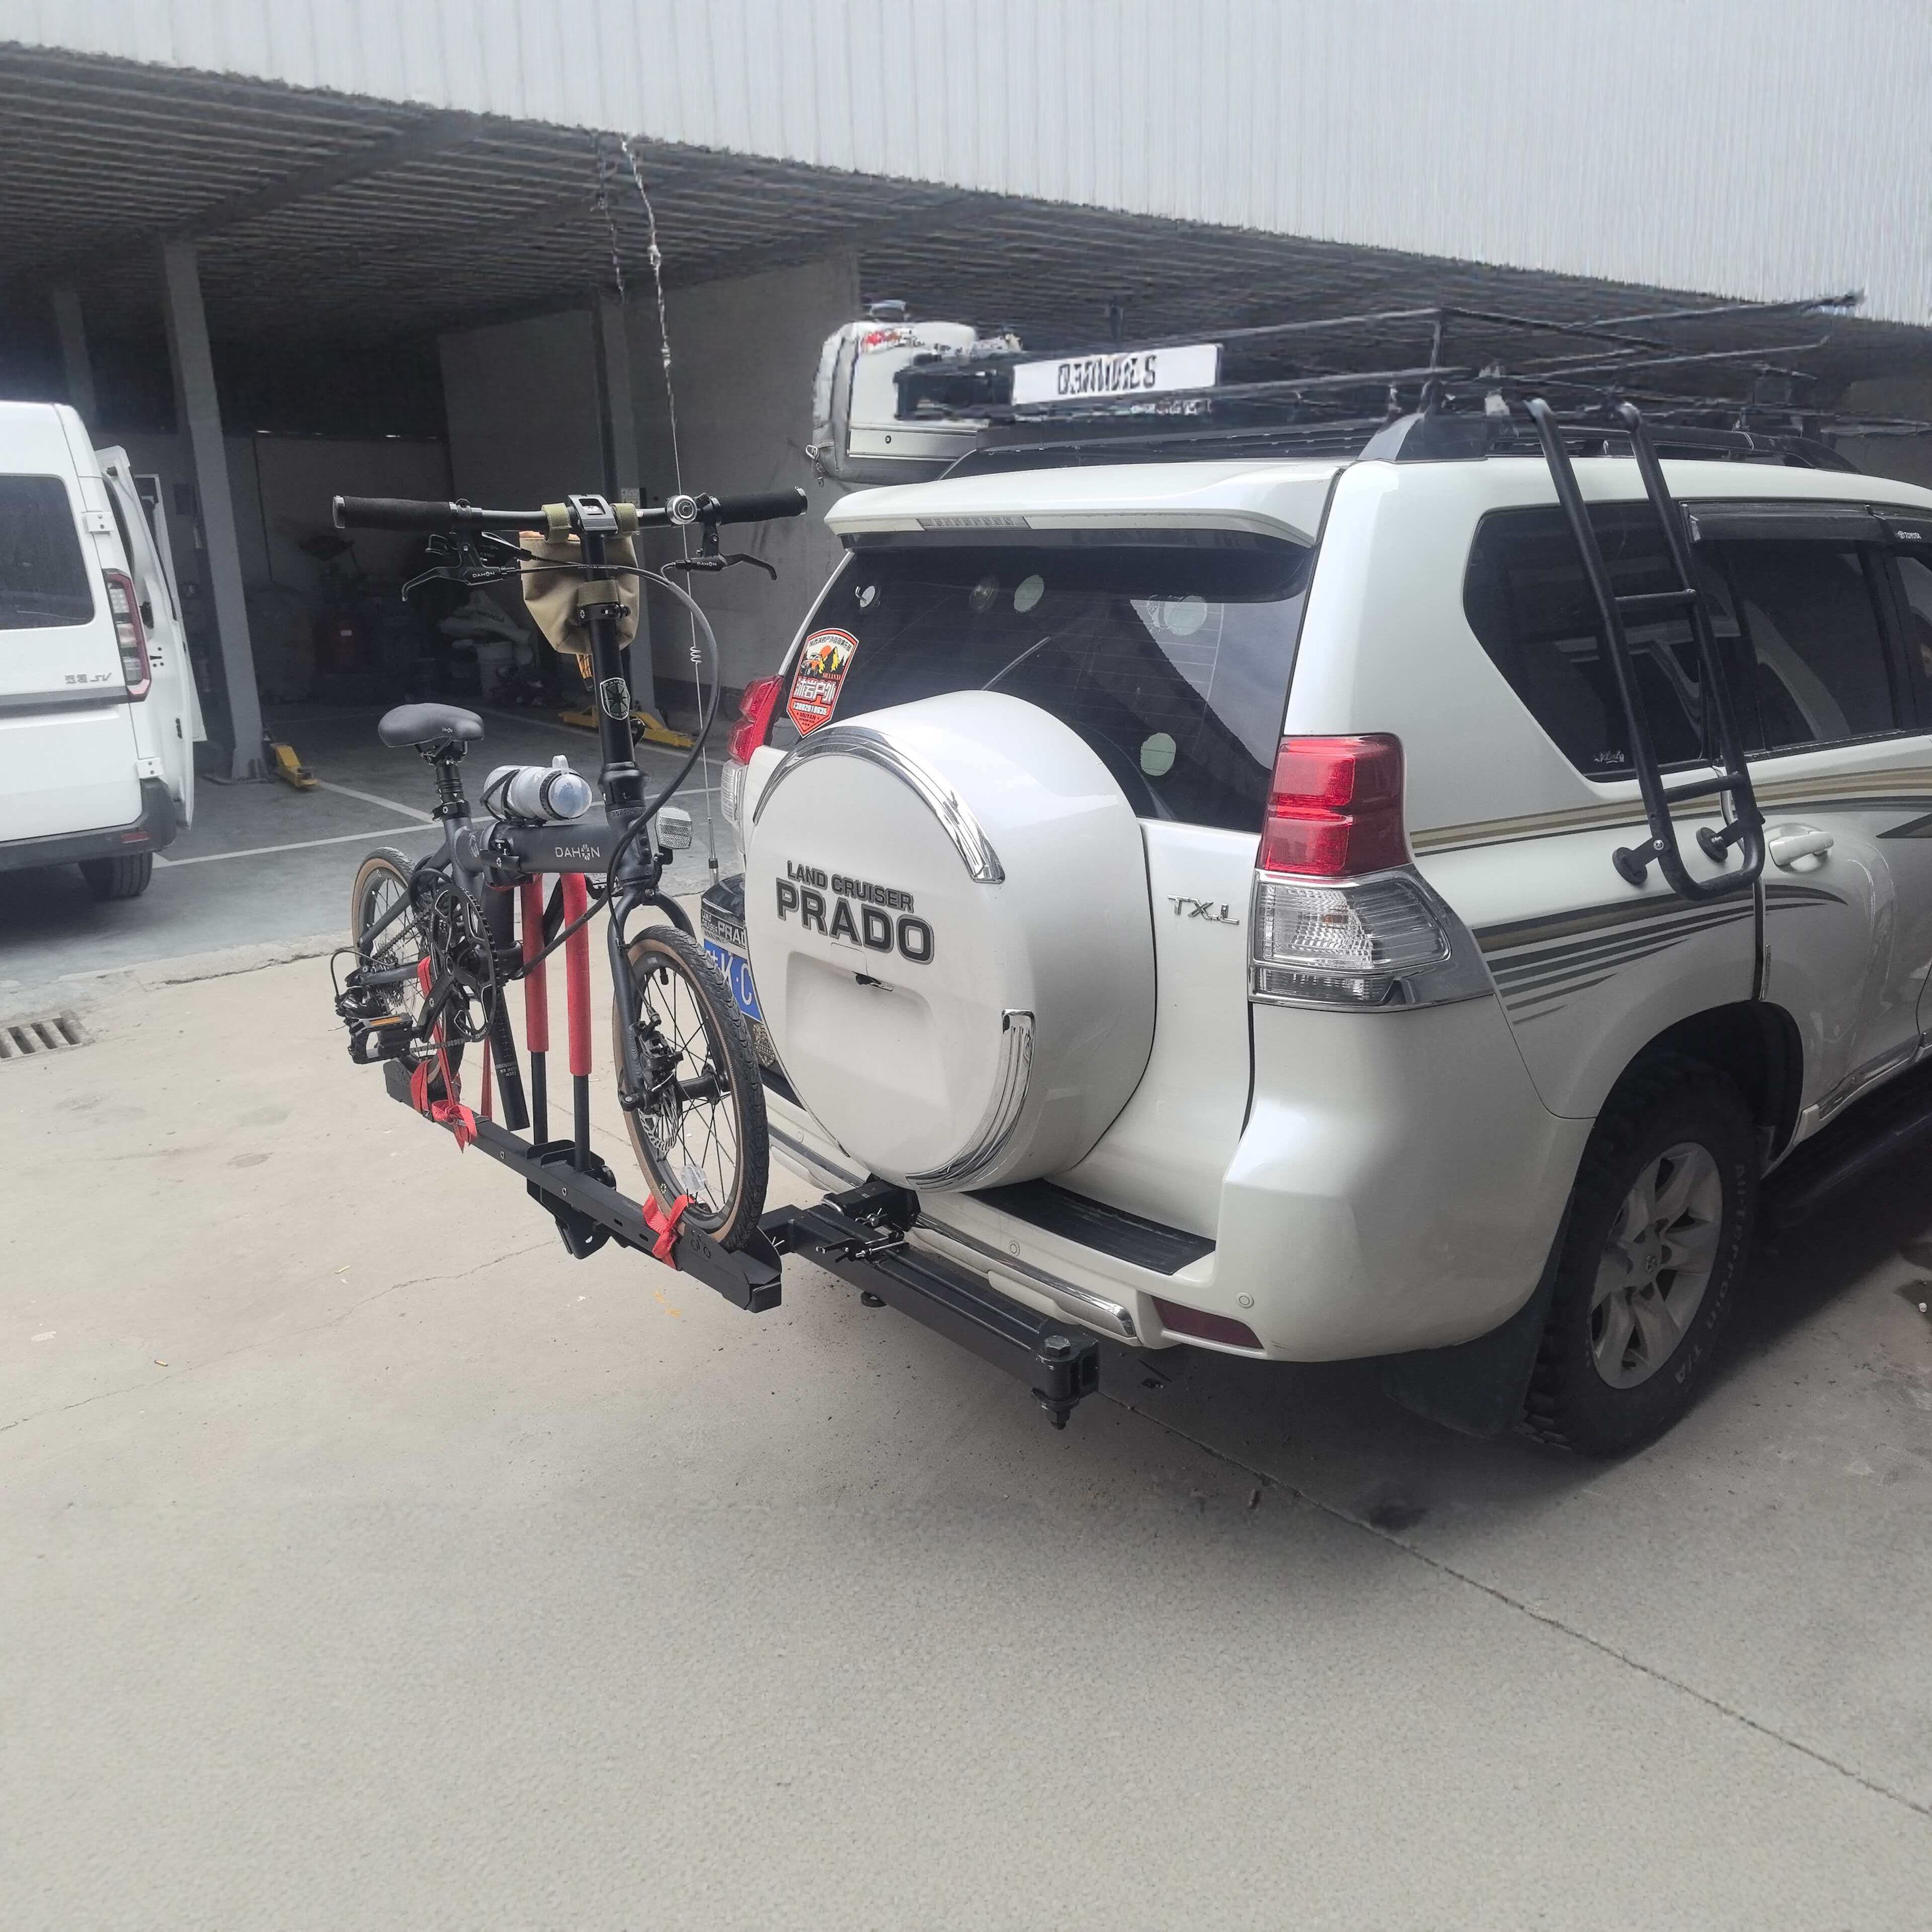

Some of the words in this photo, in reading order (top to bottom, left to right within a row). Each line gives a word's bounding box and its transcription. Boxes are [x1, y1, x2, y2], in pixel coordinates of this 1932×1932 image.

[555, 844, 600, 860] DAHON
[787, 860, 828, 890] LAND
[831, 873, 914, 913] CRUISER
[776, 877, 934, 965] PRADO
[1167, 894, 1240, 925] TXL
